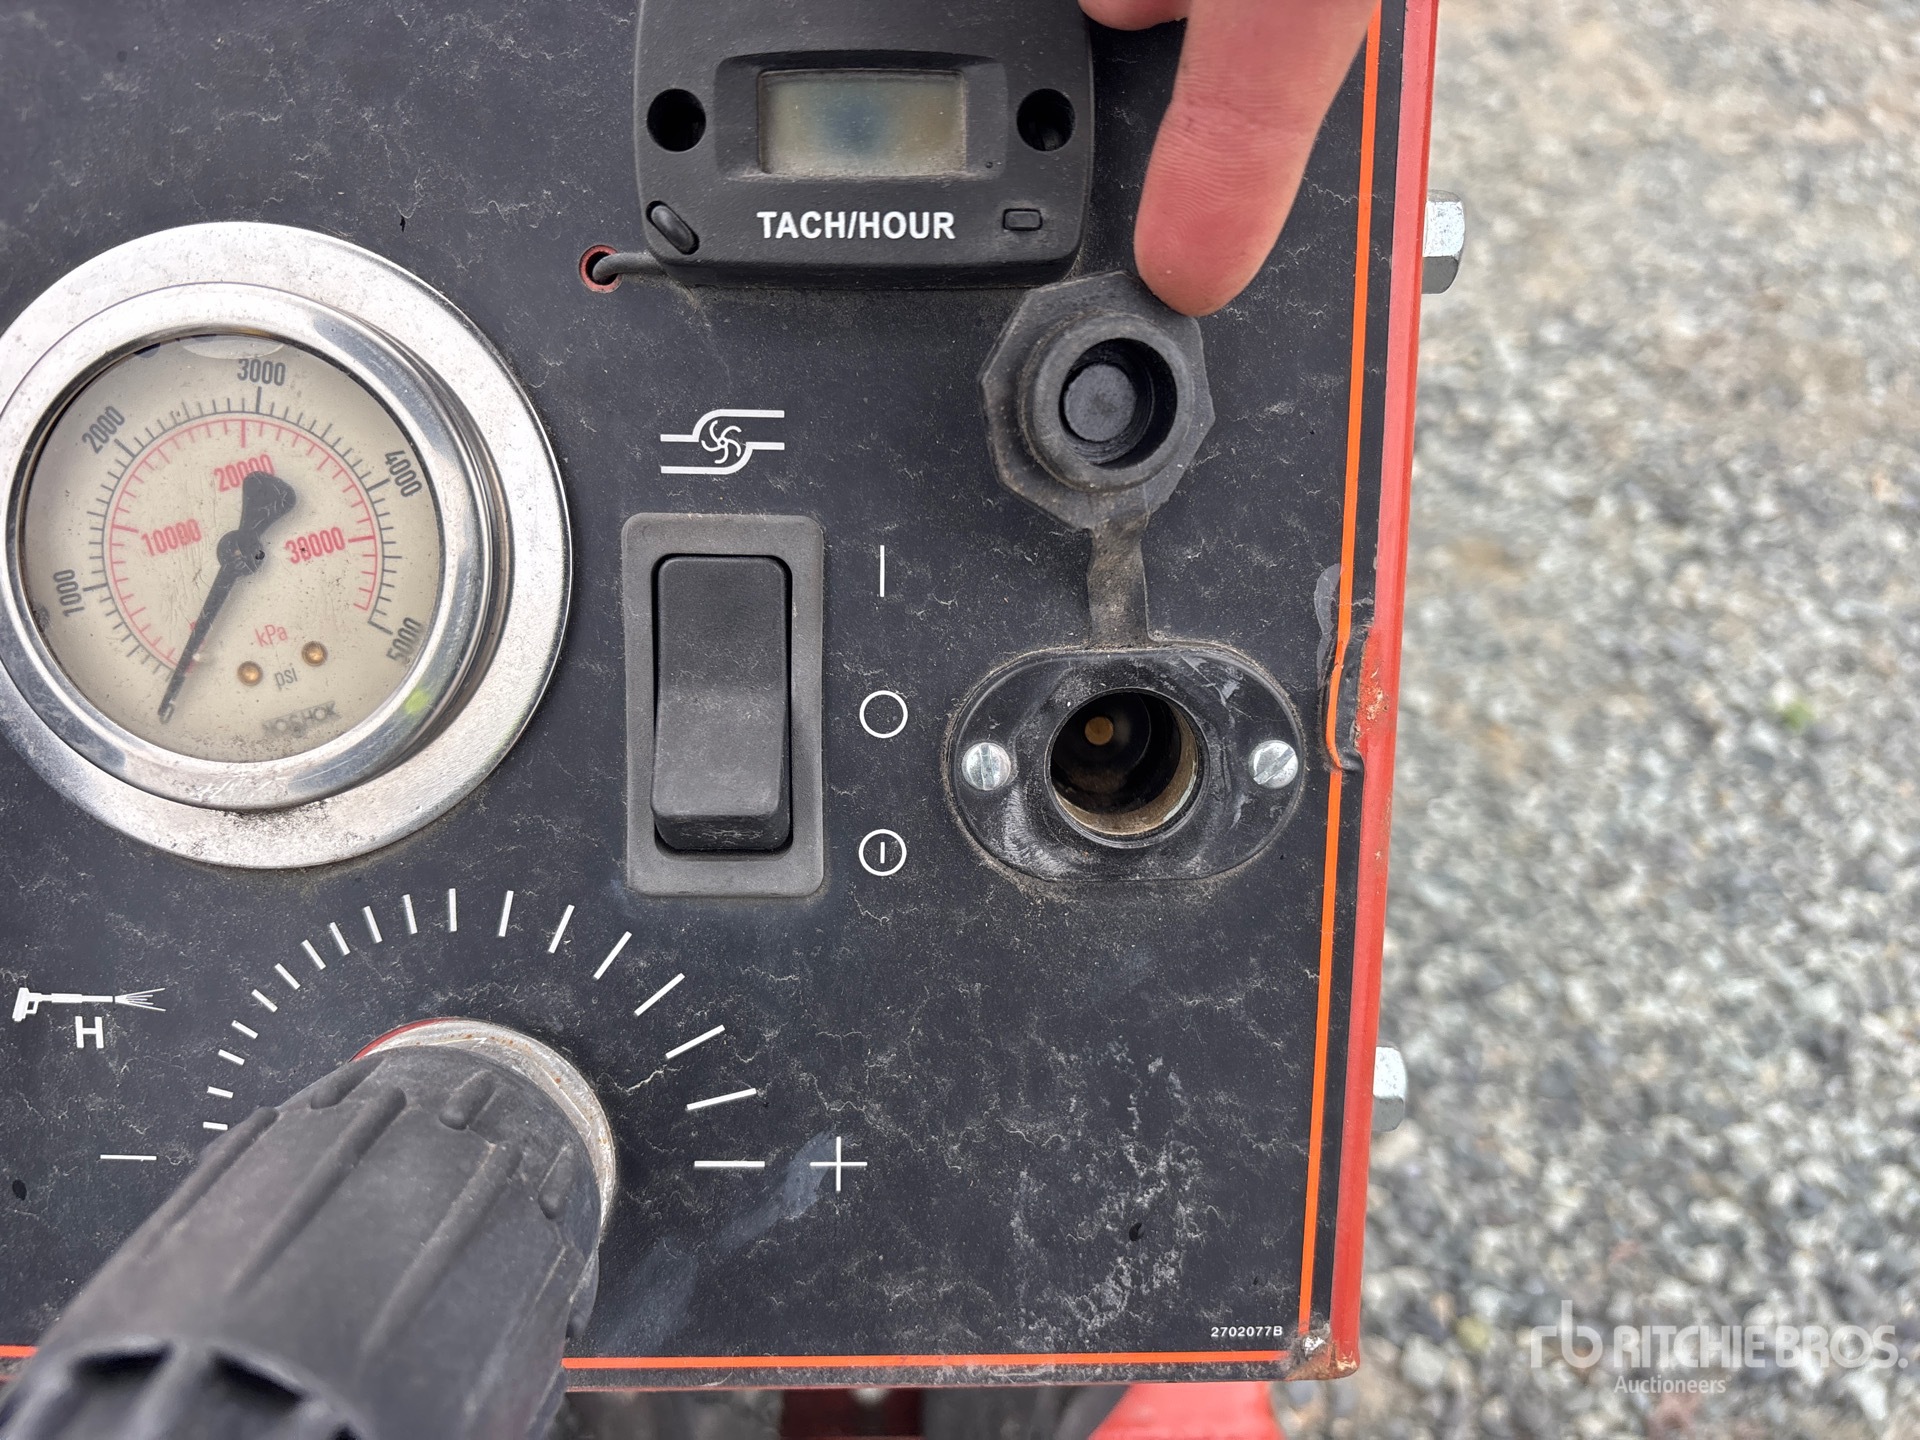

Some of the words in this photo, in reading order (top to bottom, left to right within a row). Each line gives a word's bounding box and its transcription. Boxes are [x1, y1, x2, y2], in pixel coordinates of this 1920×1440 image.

[756, 211, 956, 239] TACH/HOUR
[237, 358, 286, 386] 3000
[82, 406, 125, 453] 2000
[385, 450, 422, 497] 4000
[141, 518, 201, 556] 10000
[285, 527, 345, 564] 30000
[53, 569, 84, 616] 1000
[255, 624, 288, 647] kPa
[386, 617, 423, 664] 5000
[274, 668, 298, 690] psi
[75, 1016, 104, 1049] H
[1211, 1325, 1283, 1337] 2702077B
